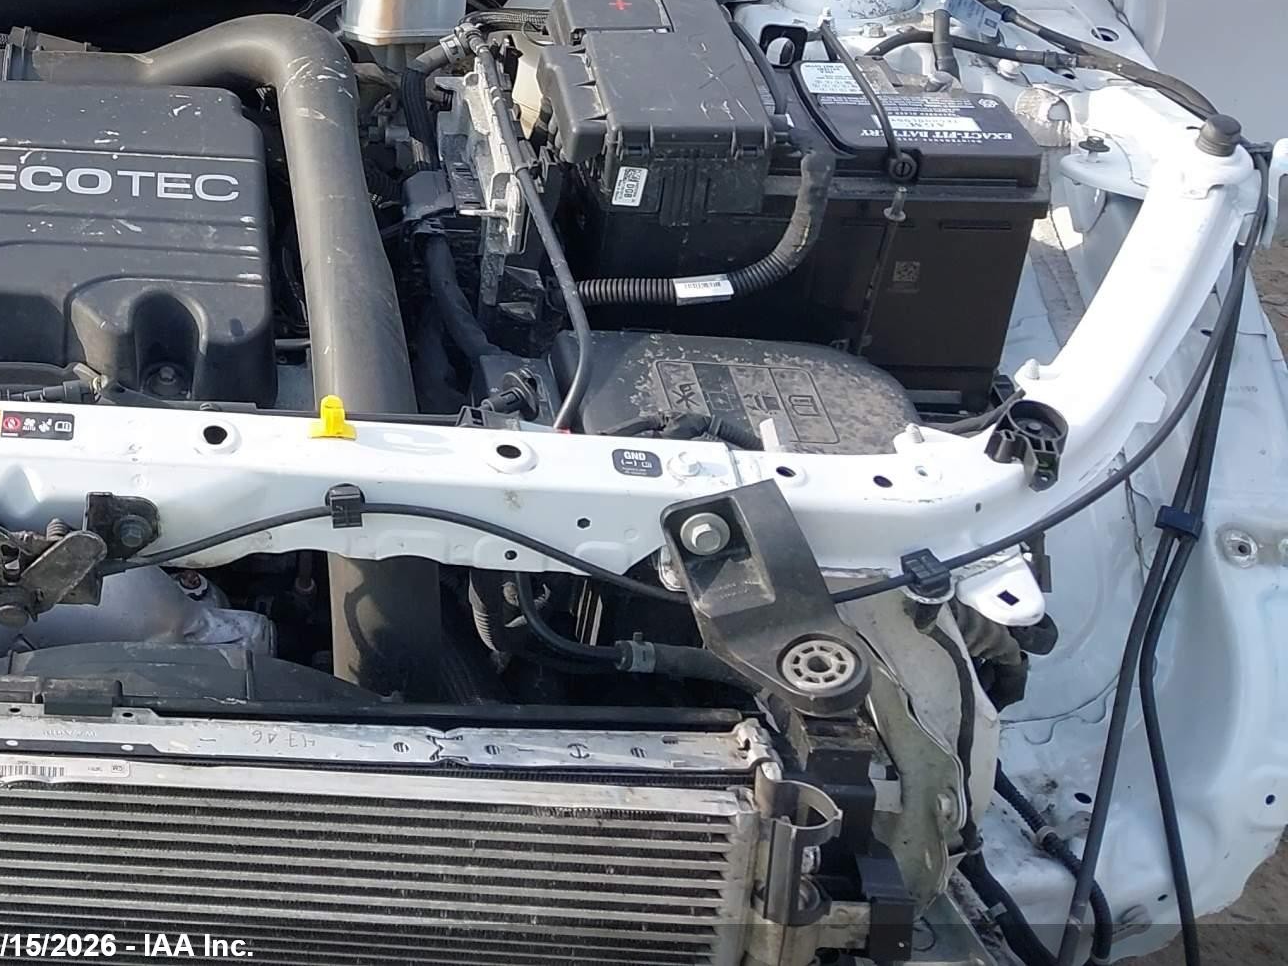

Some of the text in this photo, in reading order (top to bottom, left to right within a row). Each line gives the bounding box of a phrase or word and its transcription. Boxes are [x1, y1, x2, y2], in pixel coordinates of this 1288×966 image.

[860, 129, 1013, 140] EXACT-FIT BATTRY
[623, 451, 646, 461] GND
